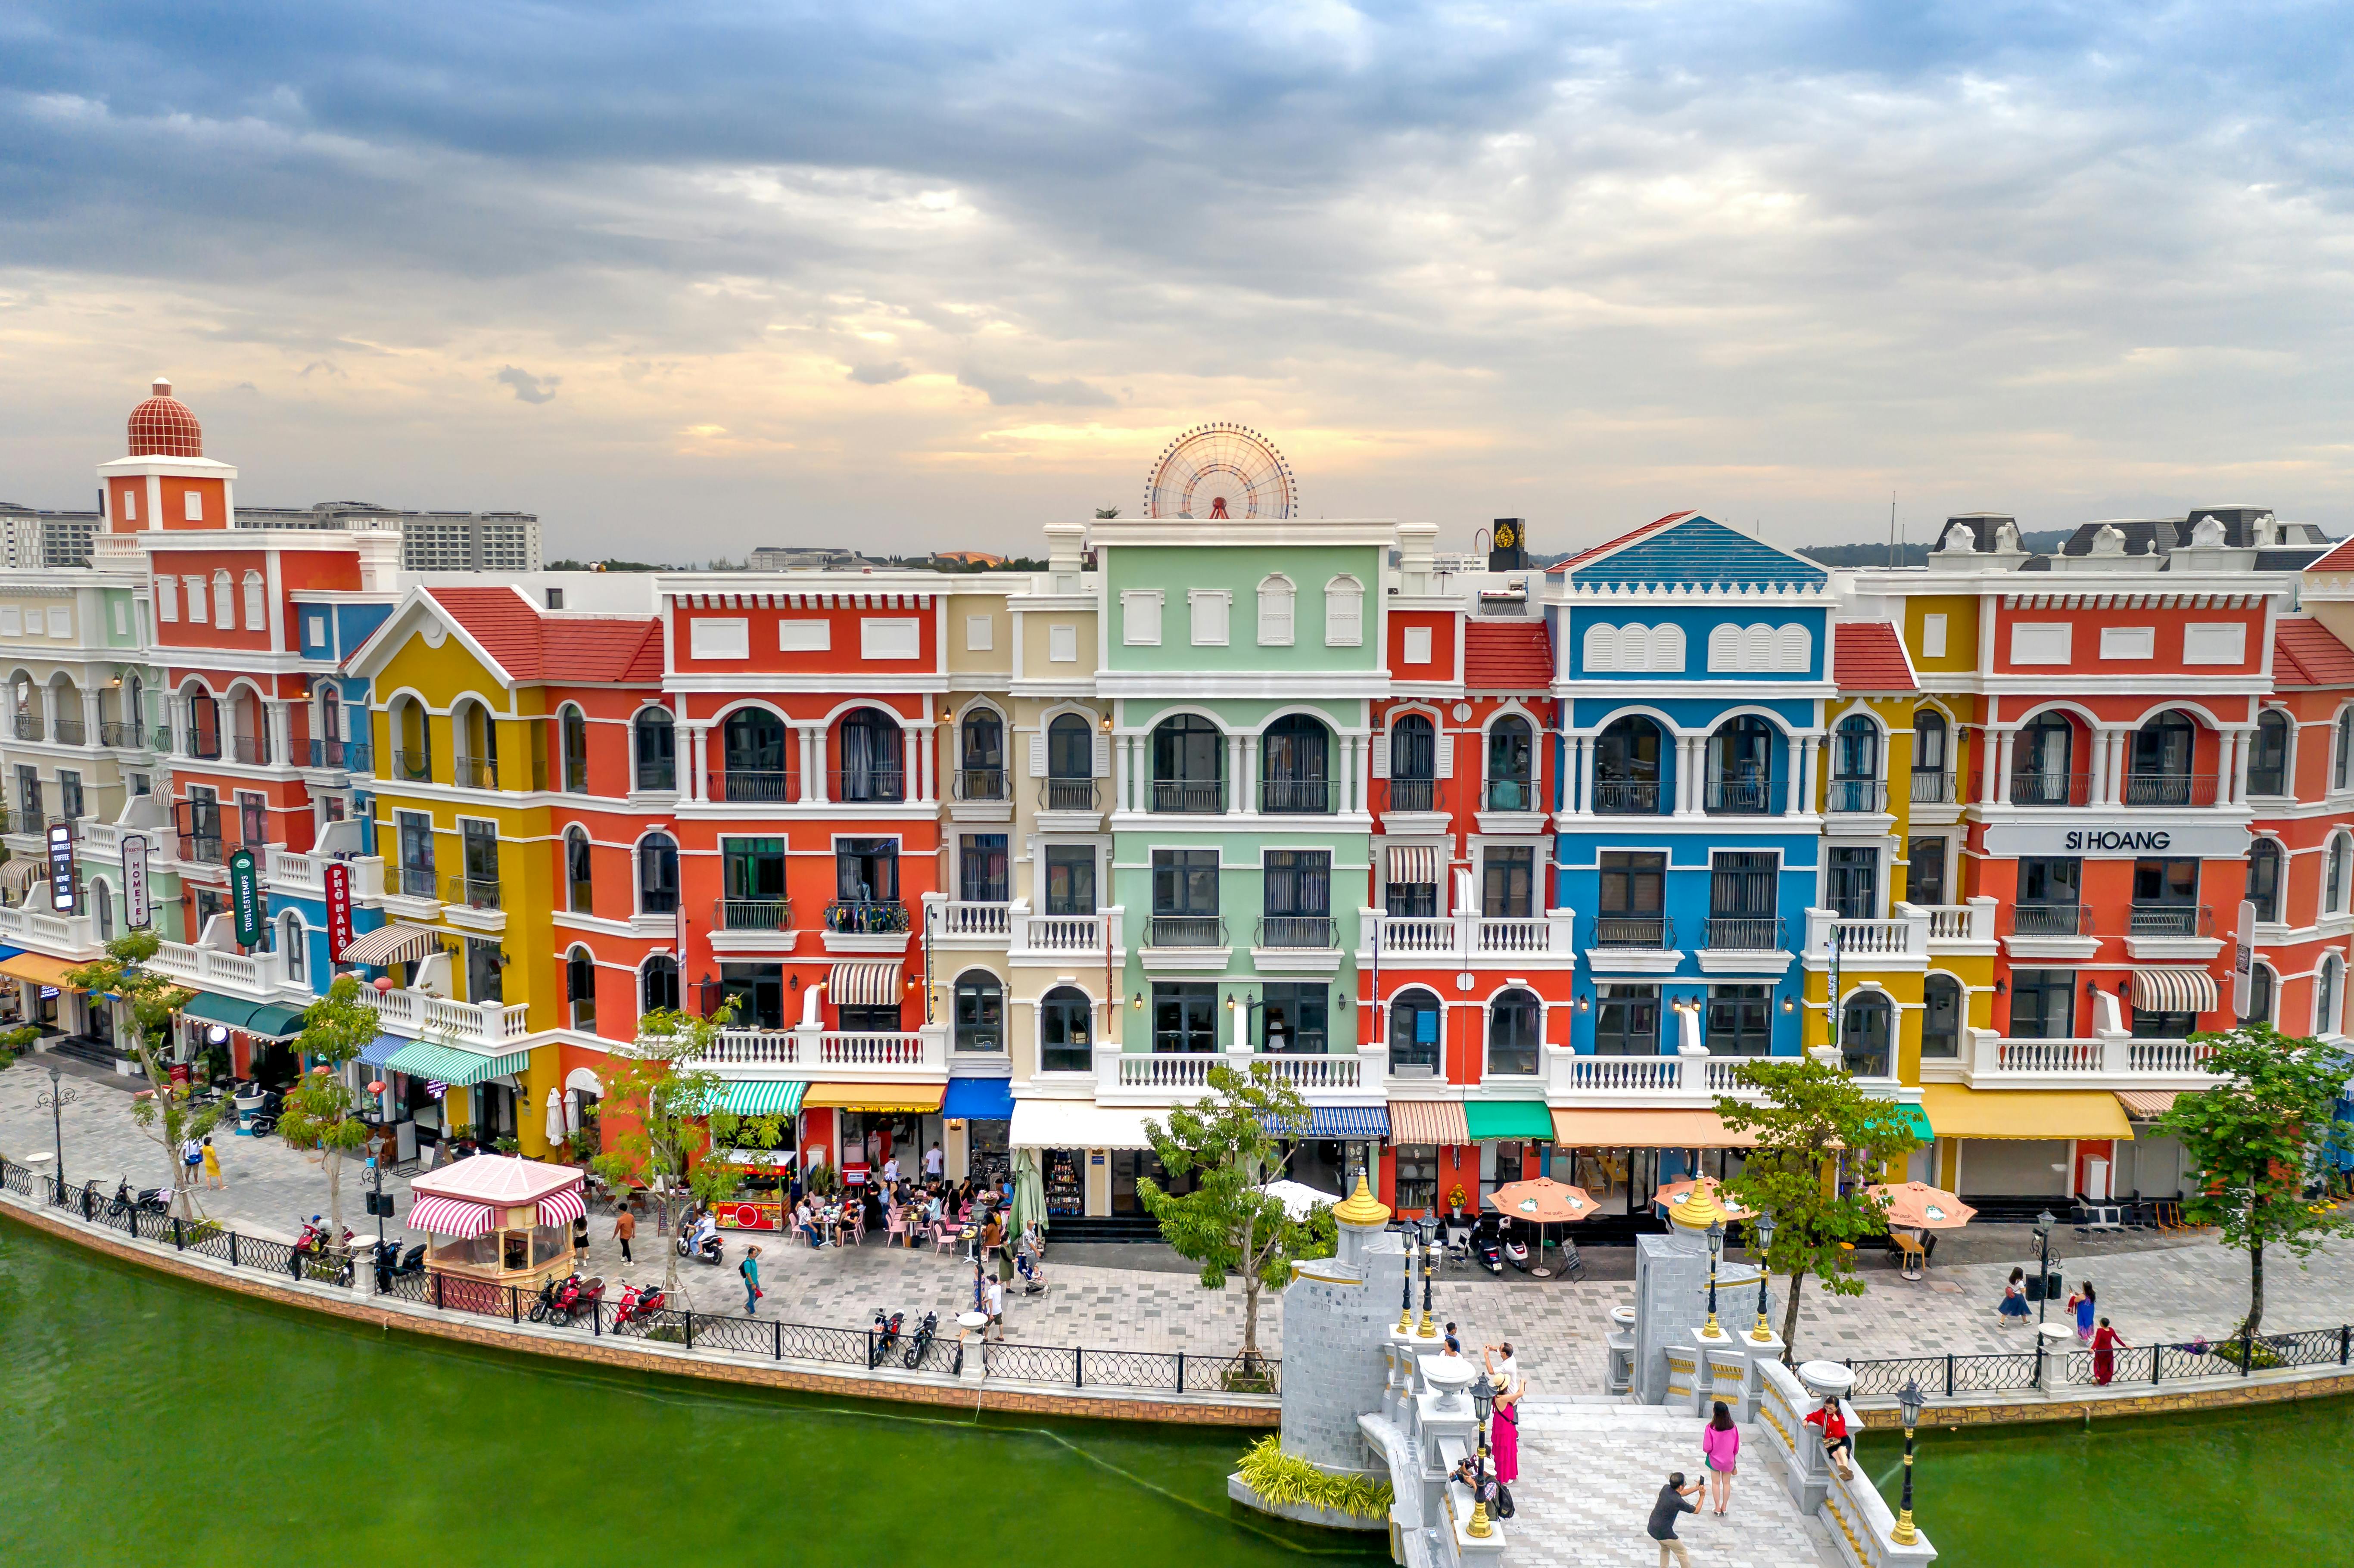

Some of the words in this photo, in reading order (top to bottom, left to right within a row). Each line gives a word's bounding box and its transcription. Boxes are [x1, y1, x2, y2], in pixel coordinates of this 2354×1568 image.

[2065, 831, 2083, 849] SI
[2087, 831, 2171, 849] HOANG
[133, 861, 142, 924] HOMETEL
[335, 903, 345, 924] HÀ
[337, 927, 347, 950] NỘ
